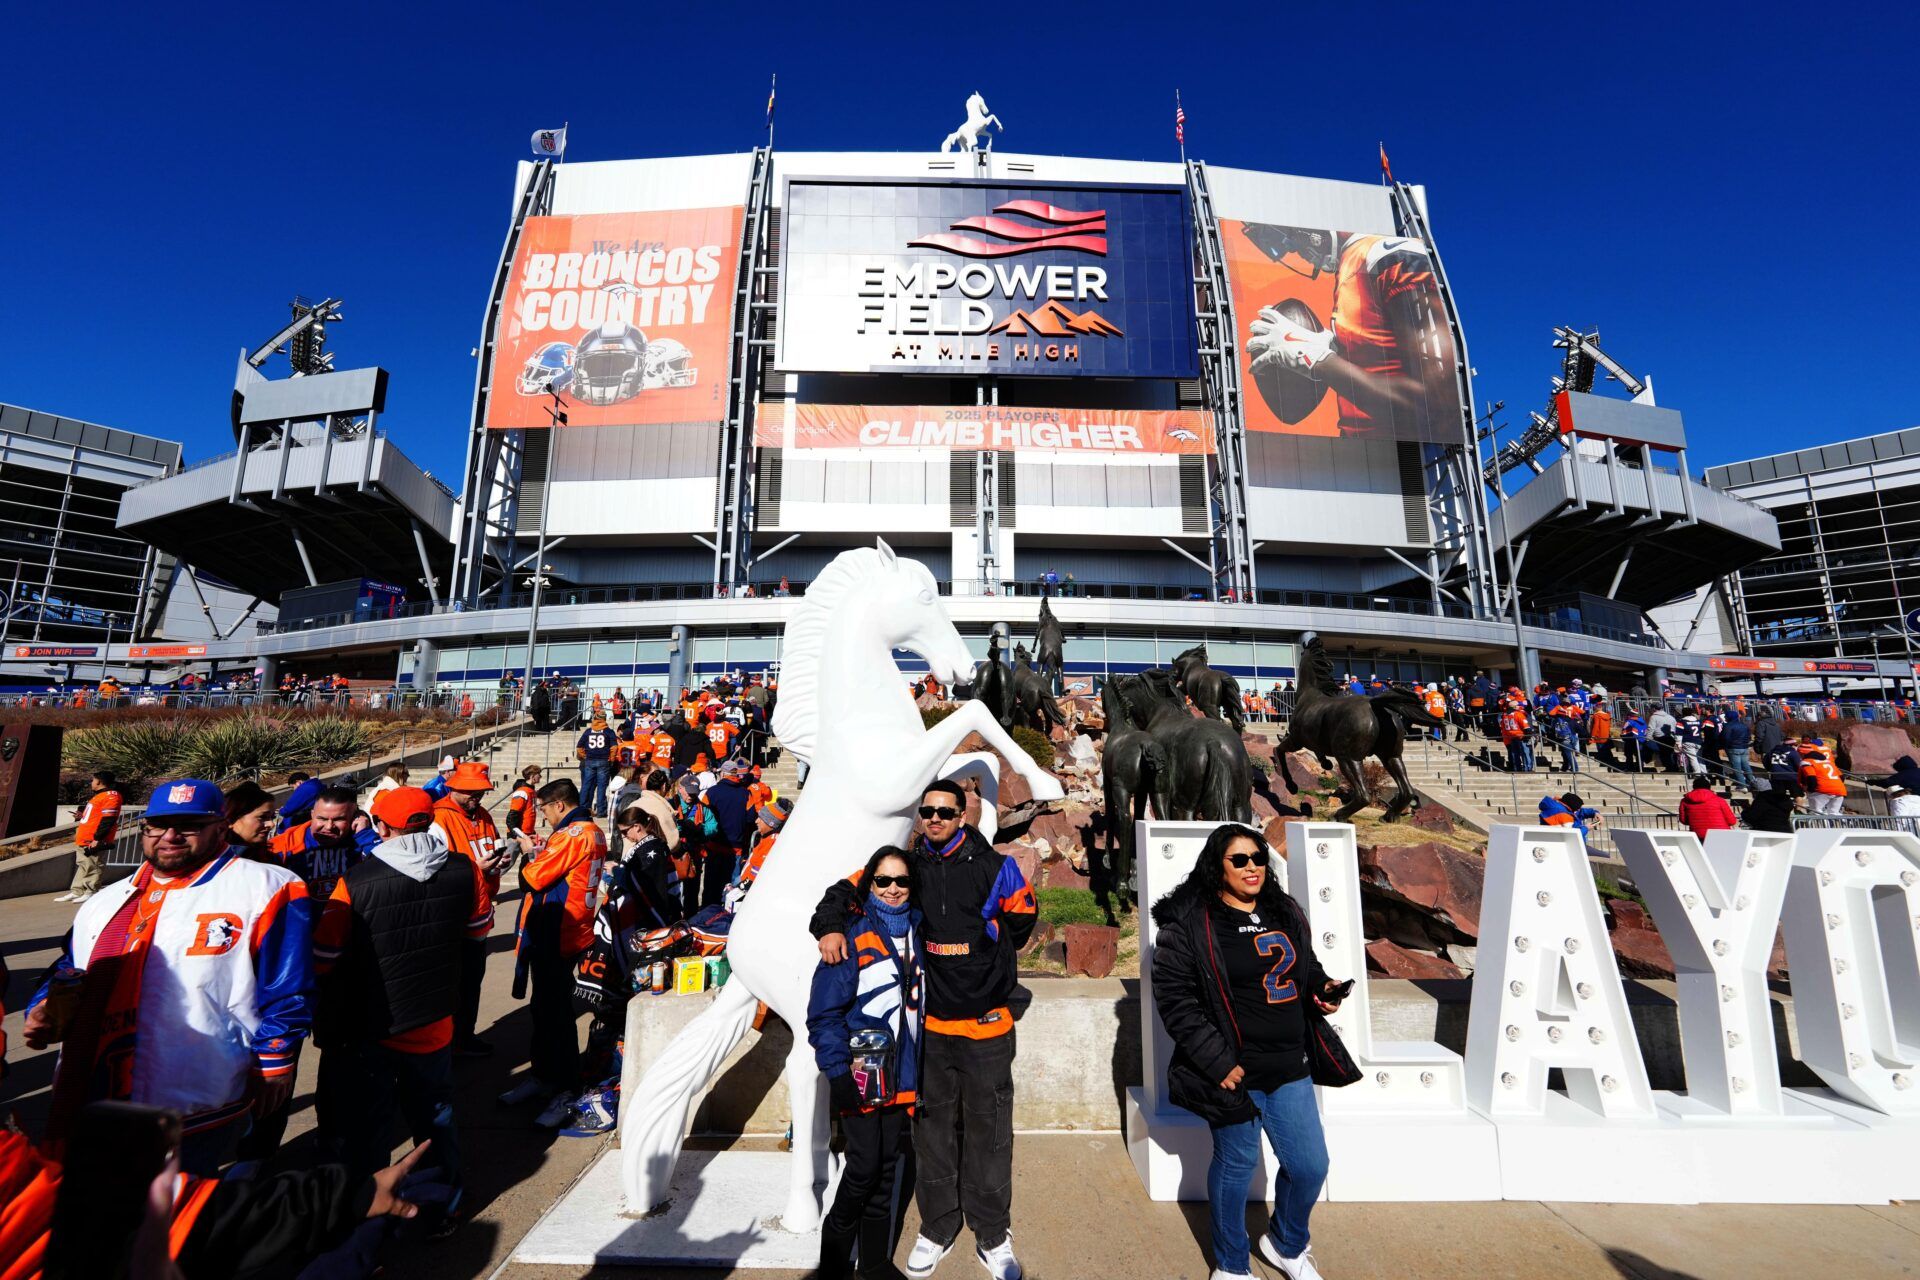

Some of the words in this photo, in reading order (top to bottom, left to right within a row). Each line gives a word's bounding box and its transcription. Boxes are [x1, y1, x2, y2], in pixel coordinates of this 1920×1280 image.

[591, 240, 622, 257] We
[625, 238, 664, 254] Are
[525, 245, 722, 290] BRONCOS
[857, 262, 1109, 301] EMPOWER
[521, 283, 715, 331] COUNTRY
[856, 299, 995, 335] FIELD
[891, 344, 922, 360] AT
[938, 344, 1000, 361] MILE
[1015, 344, 1079, 362] HIGH
[945, 410, 982, 421] 2025
[986, 410, 1060, 423] PLAYOFFS
[859, 420, 985, 447] CLIMB
[992, 421, 1144, 449] HIGHER
[31, 648, 52, 656] JOIN
[53, 647, 72, 656] WIFI
[1818, 663, 1837, 671] JOIN
[1837, 663, 1854, 671] WIFI
[1691, 726, 1700, 737] 2
[588, 735, 606, 749] 58
[656, 745, 672, 758] 23
[1823, 764, 1838, 780] 2
[926, 940, 970, 956] BRONCOS
[1253, 930, 1299, 1004] 2
